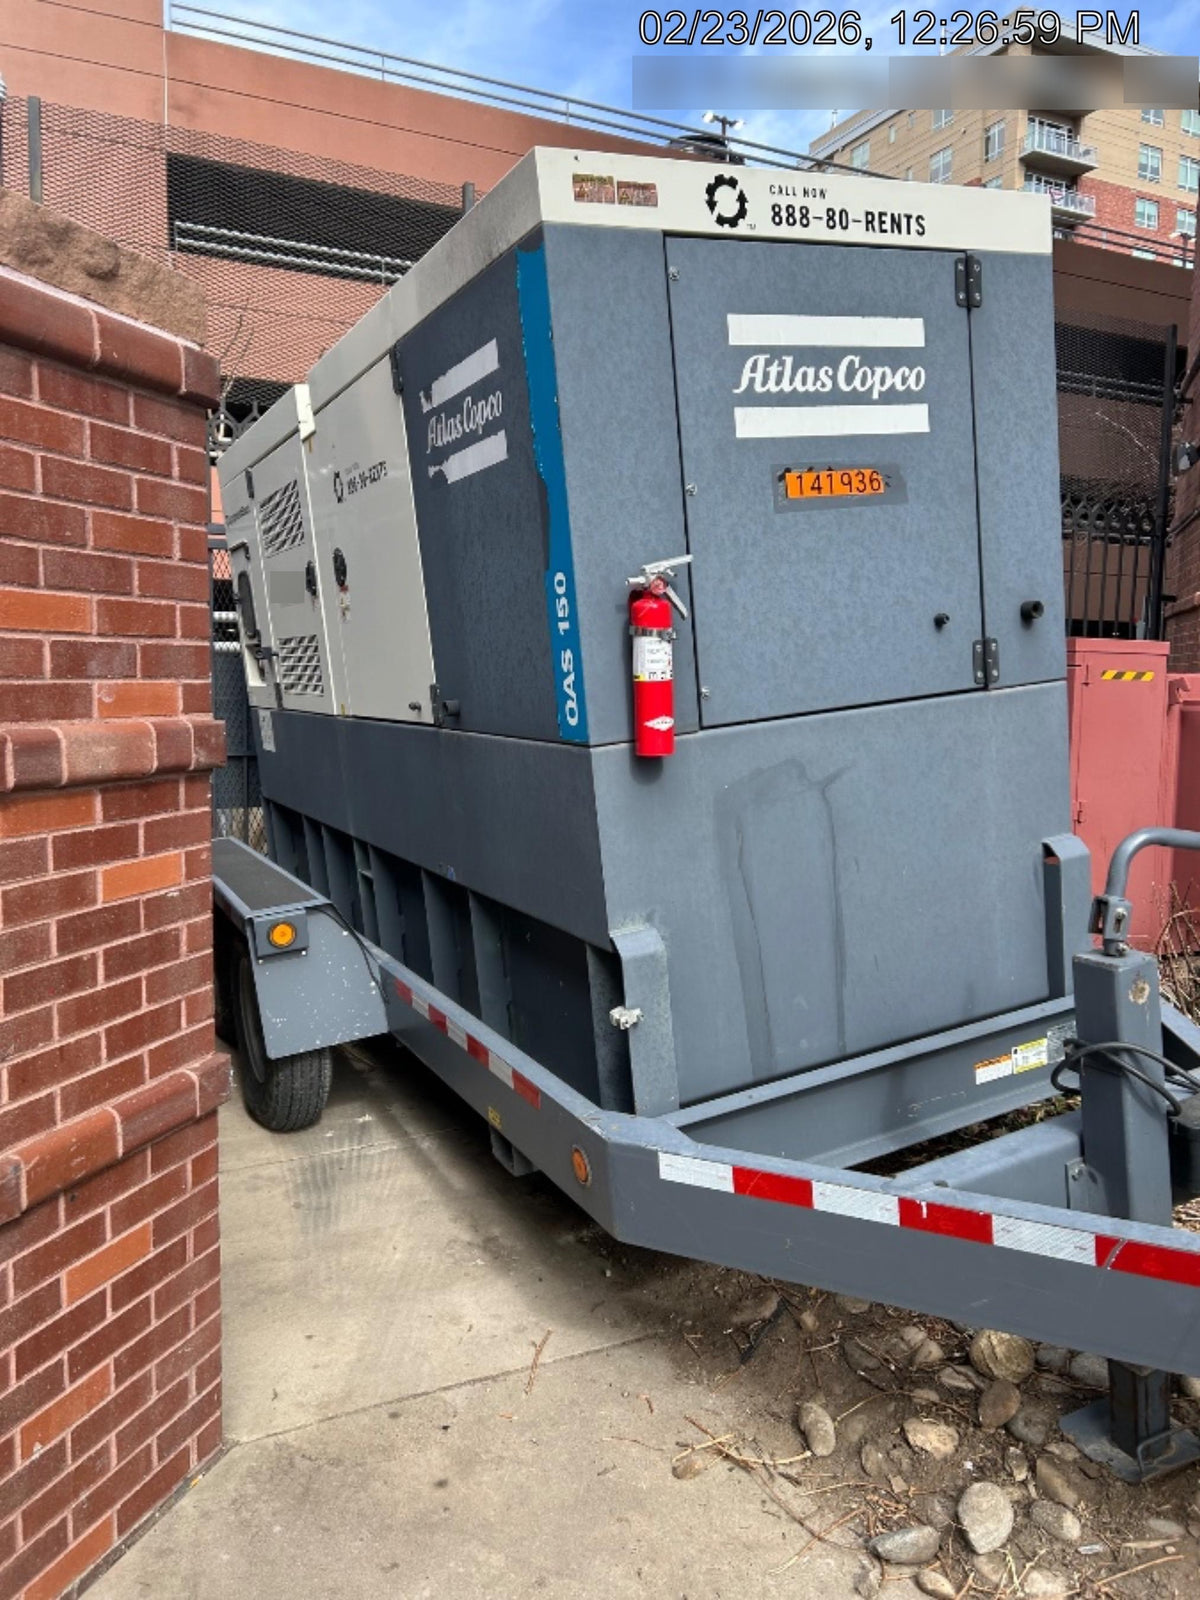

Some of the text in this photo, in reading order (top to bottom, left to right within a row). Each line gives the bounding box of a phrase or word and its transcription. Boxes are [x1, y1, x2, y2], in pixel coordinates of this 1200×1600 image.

[769, 184, 827, 200] CALL NOW
[771, 203, 926, 237] 888-80-RENTS
[732, 354, 925, 400] Atlas Copco
[426, 390, 502, 454] Atlas Copco
[796, 469, 881, 496] 141936
[554, 571, 579, 726] QAS 150
